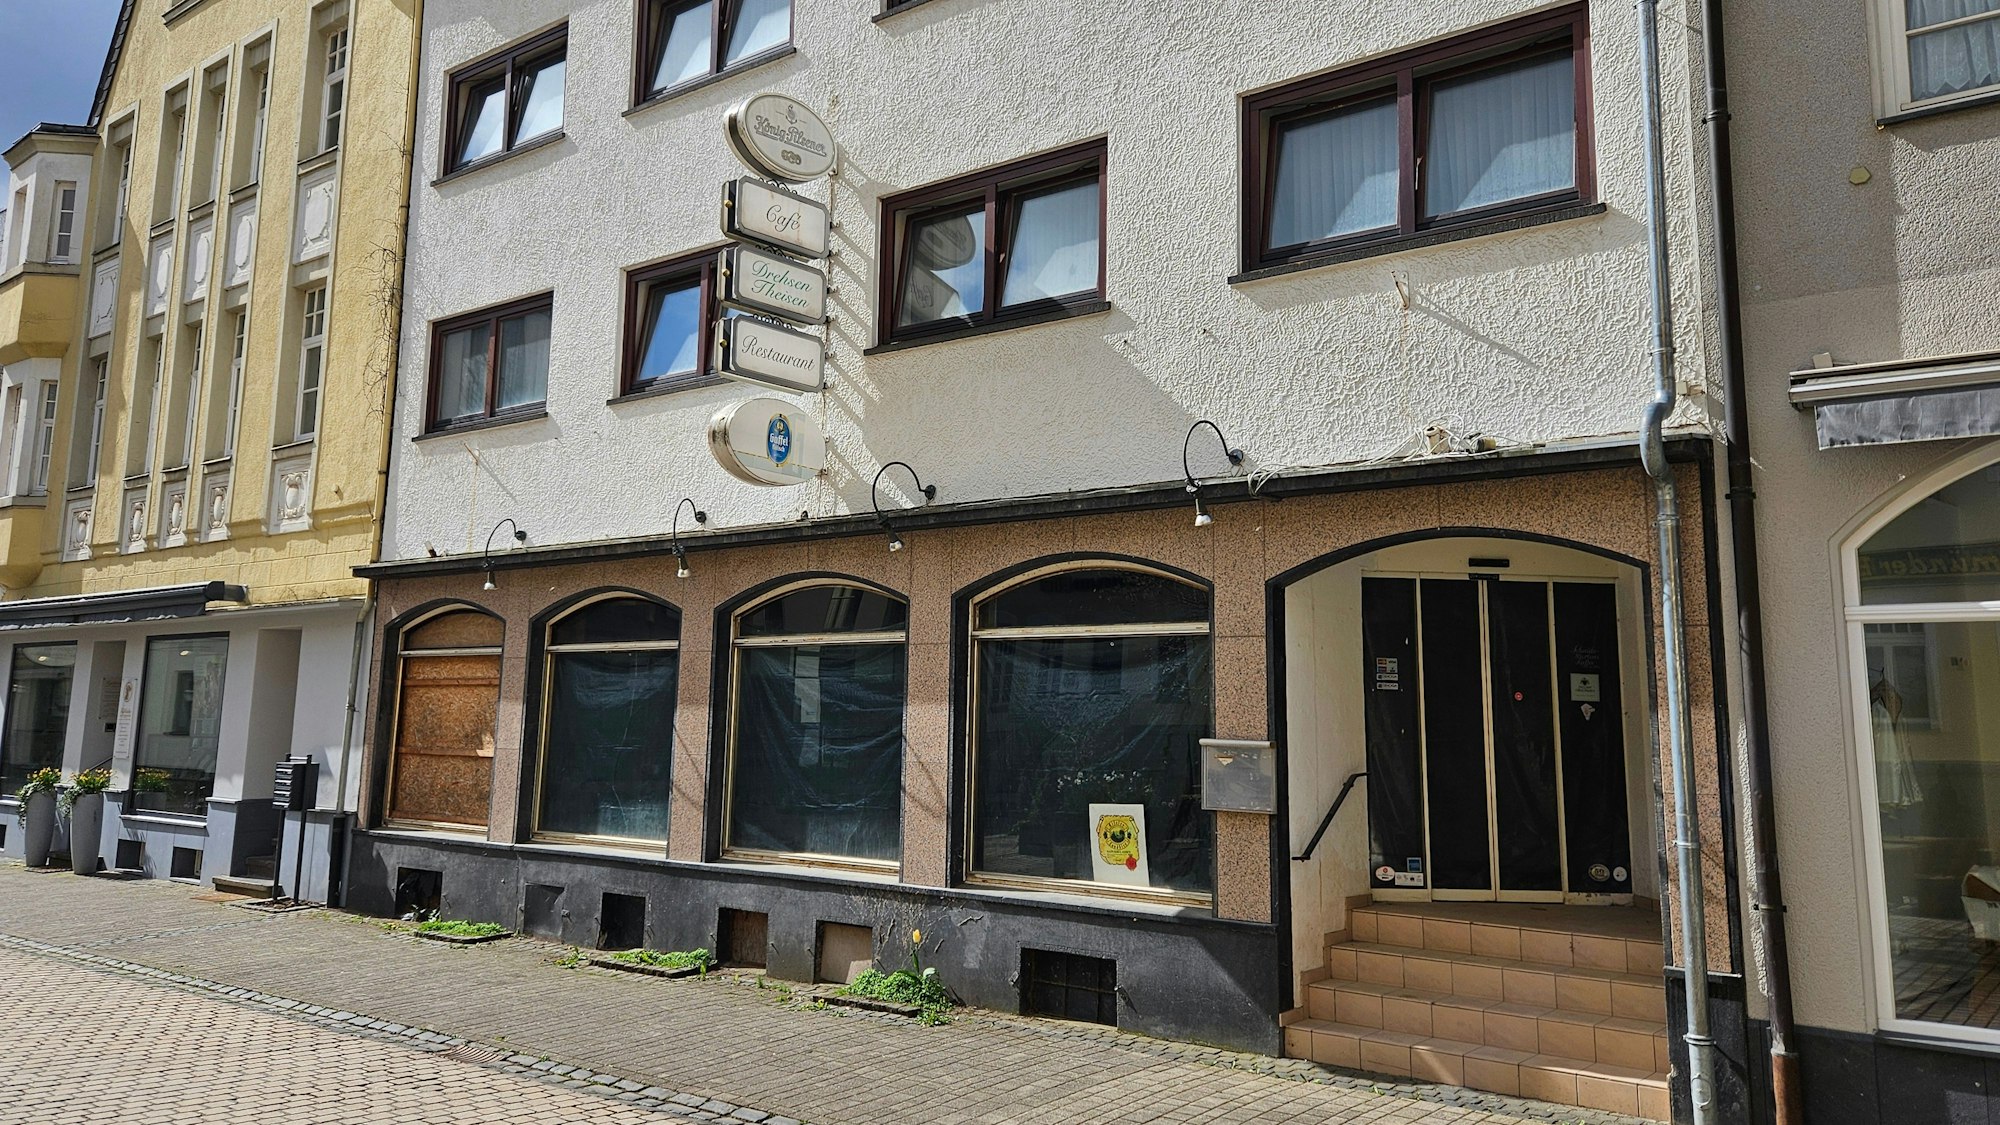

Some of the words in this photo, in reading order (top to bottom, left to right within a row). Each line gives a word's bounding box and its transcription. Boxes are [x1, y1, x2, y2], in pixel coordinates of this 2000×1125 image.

[766, 204, 801, 232] Café
[751, 260, 813, 292] Drehsen
[751, 279, 810, 308] Theisen
[741, 334, 816, 371] Restaurant
[770, 432, 789, 447] Gaffel
